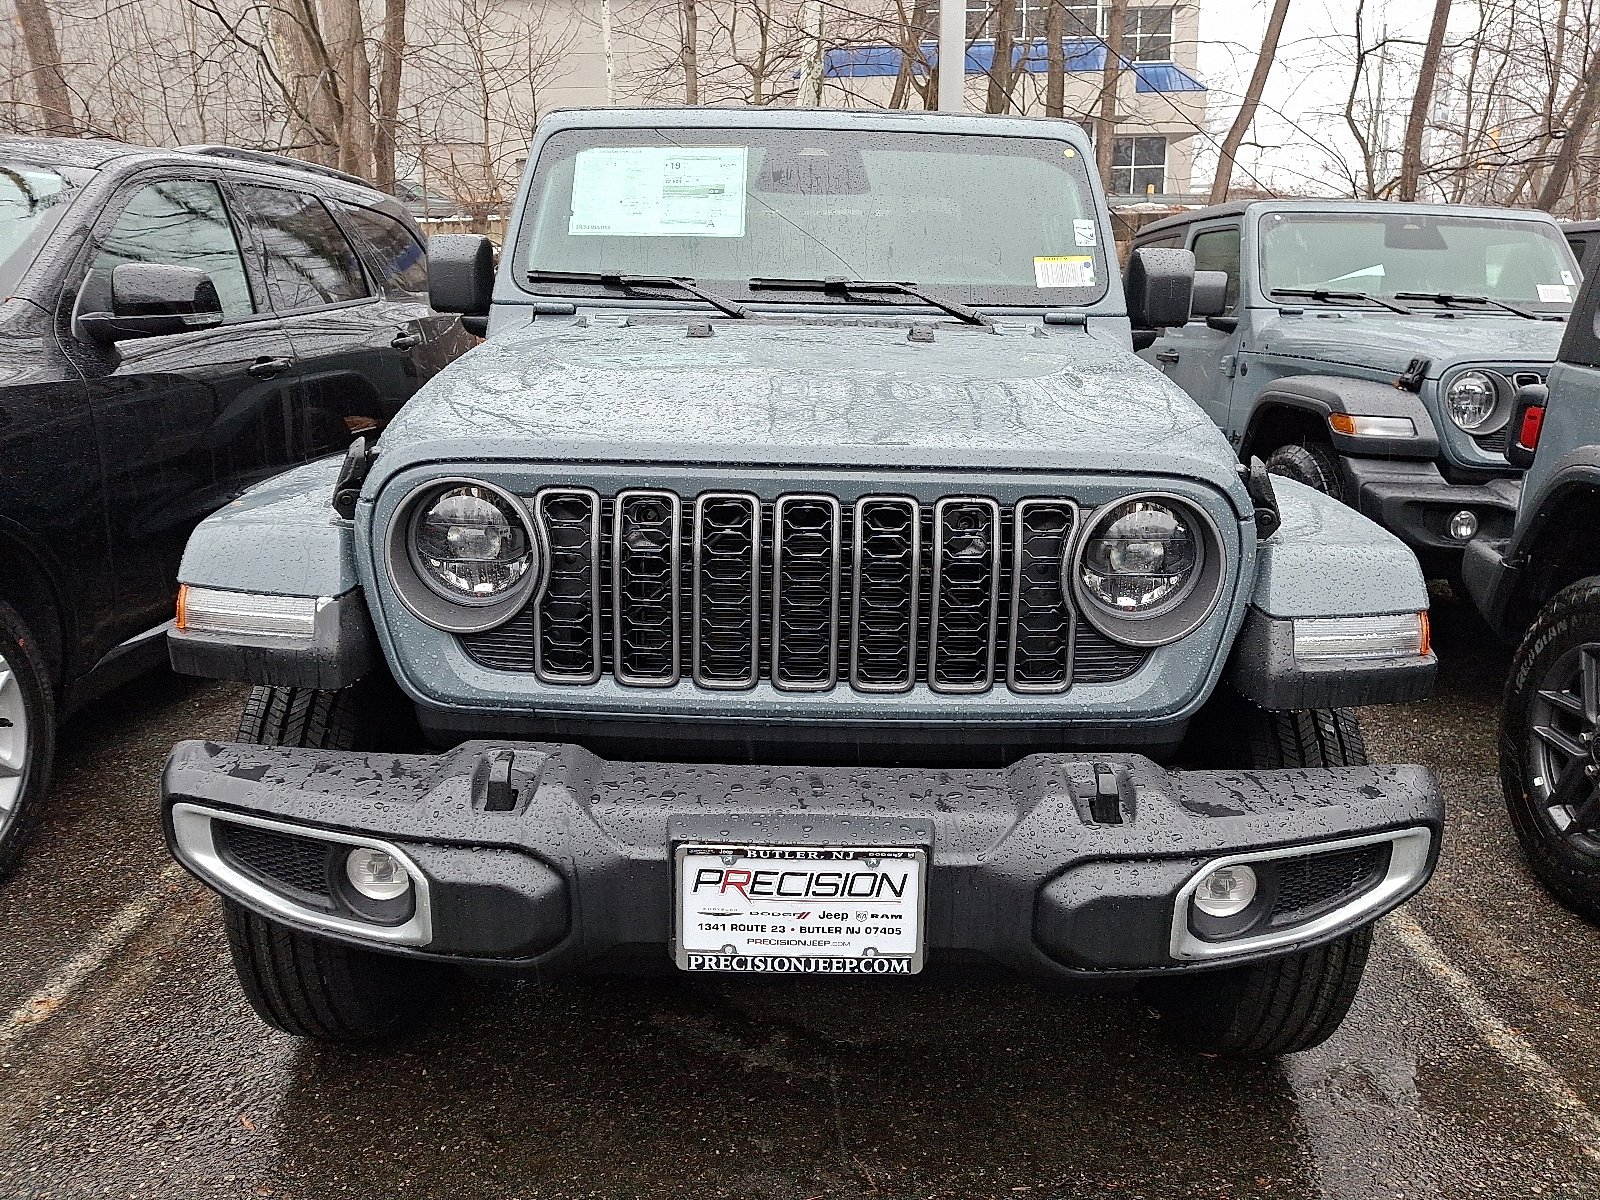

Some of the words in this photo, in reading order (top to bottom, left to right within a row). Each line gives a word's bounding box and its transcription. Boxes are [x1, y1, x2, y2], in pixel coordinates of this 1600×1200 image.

[747, 850, 825, 860] BUTLER,
[831, 851, 855, 861] NJ
[693, 868, 908, 900] PRECISION
[818, 910, 849, 922] Jeep
[697, 923, 726, 932] 1341
[731, 924, 767, 933] ROUTE
[771, 925, 786, 934] 23
[800, 925, 842, 935] BUTLER
[846, 926, 861, 935] NJ
[865, 926, 902, 936] 07405
[687, 955, 911, 974] PRECISIONJEEP.COM
